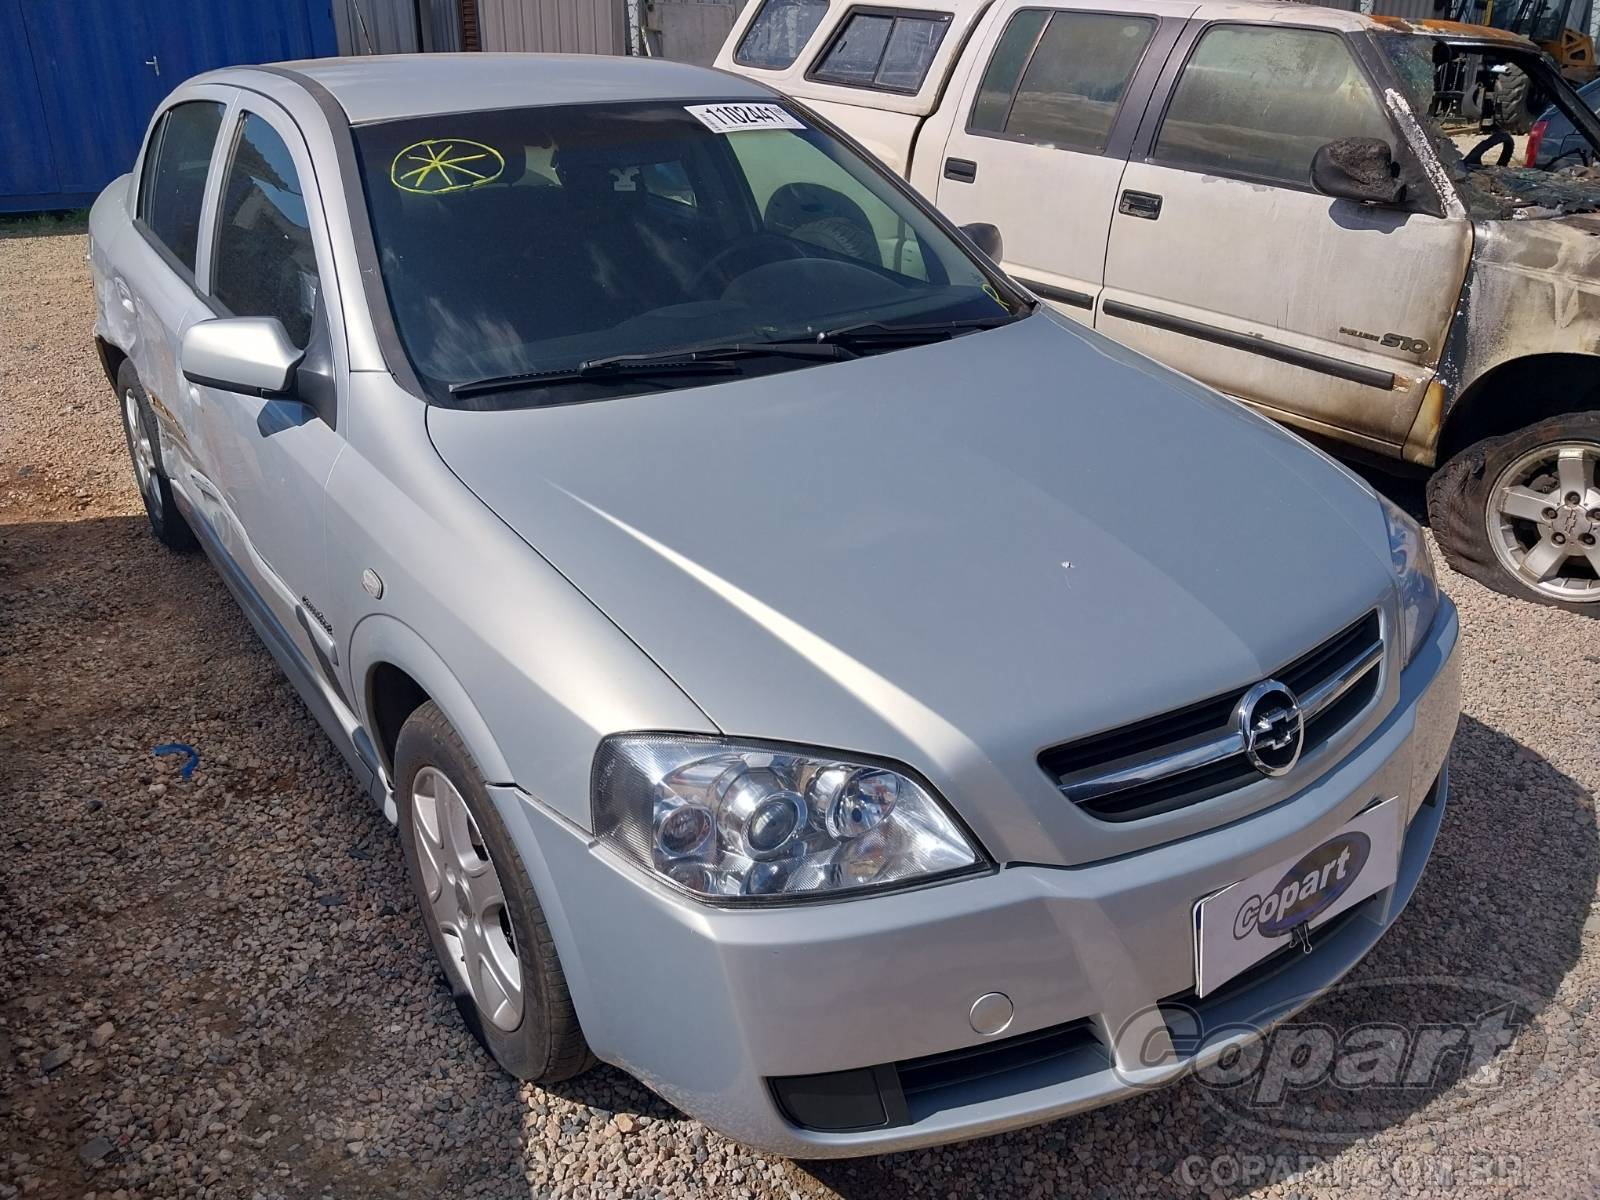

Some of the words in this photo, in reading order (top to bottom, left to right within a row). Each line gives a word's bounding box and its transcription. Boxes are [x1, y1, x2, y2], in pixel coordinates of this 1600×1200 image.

[705, 105, 785, 125] 1102441
[1380, 332, 1430, 355] S10
[1233, 845, 1351, 941] Copart
